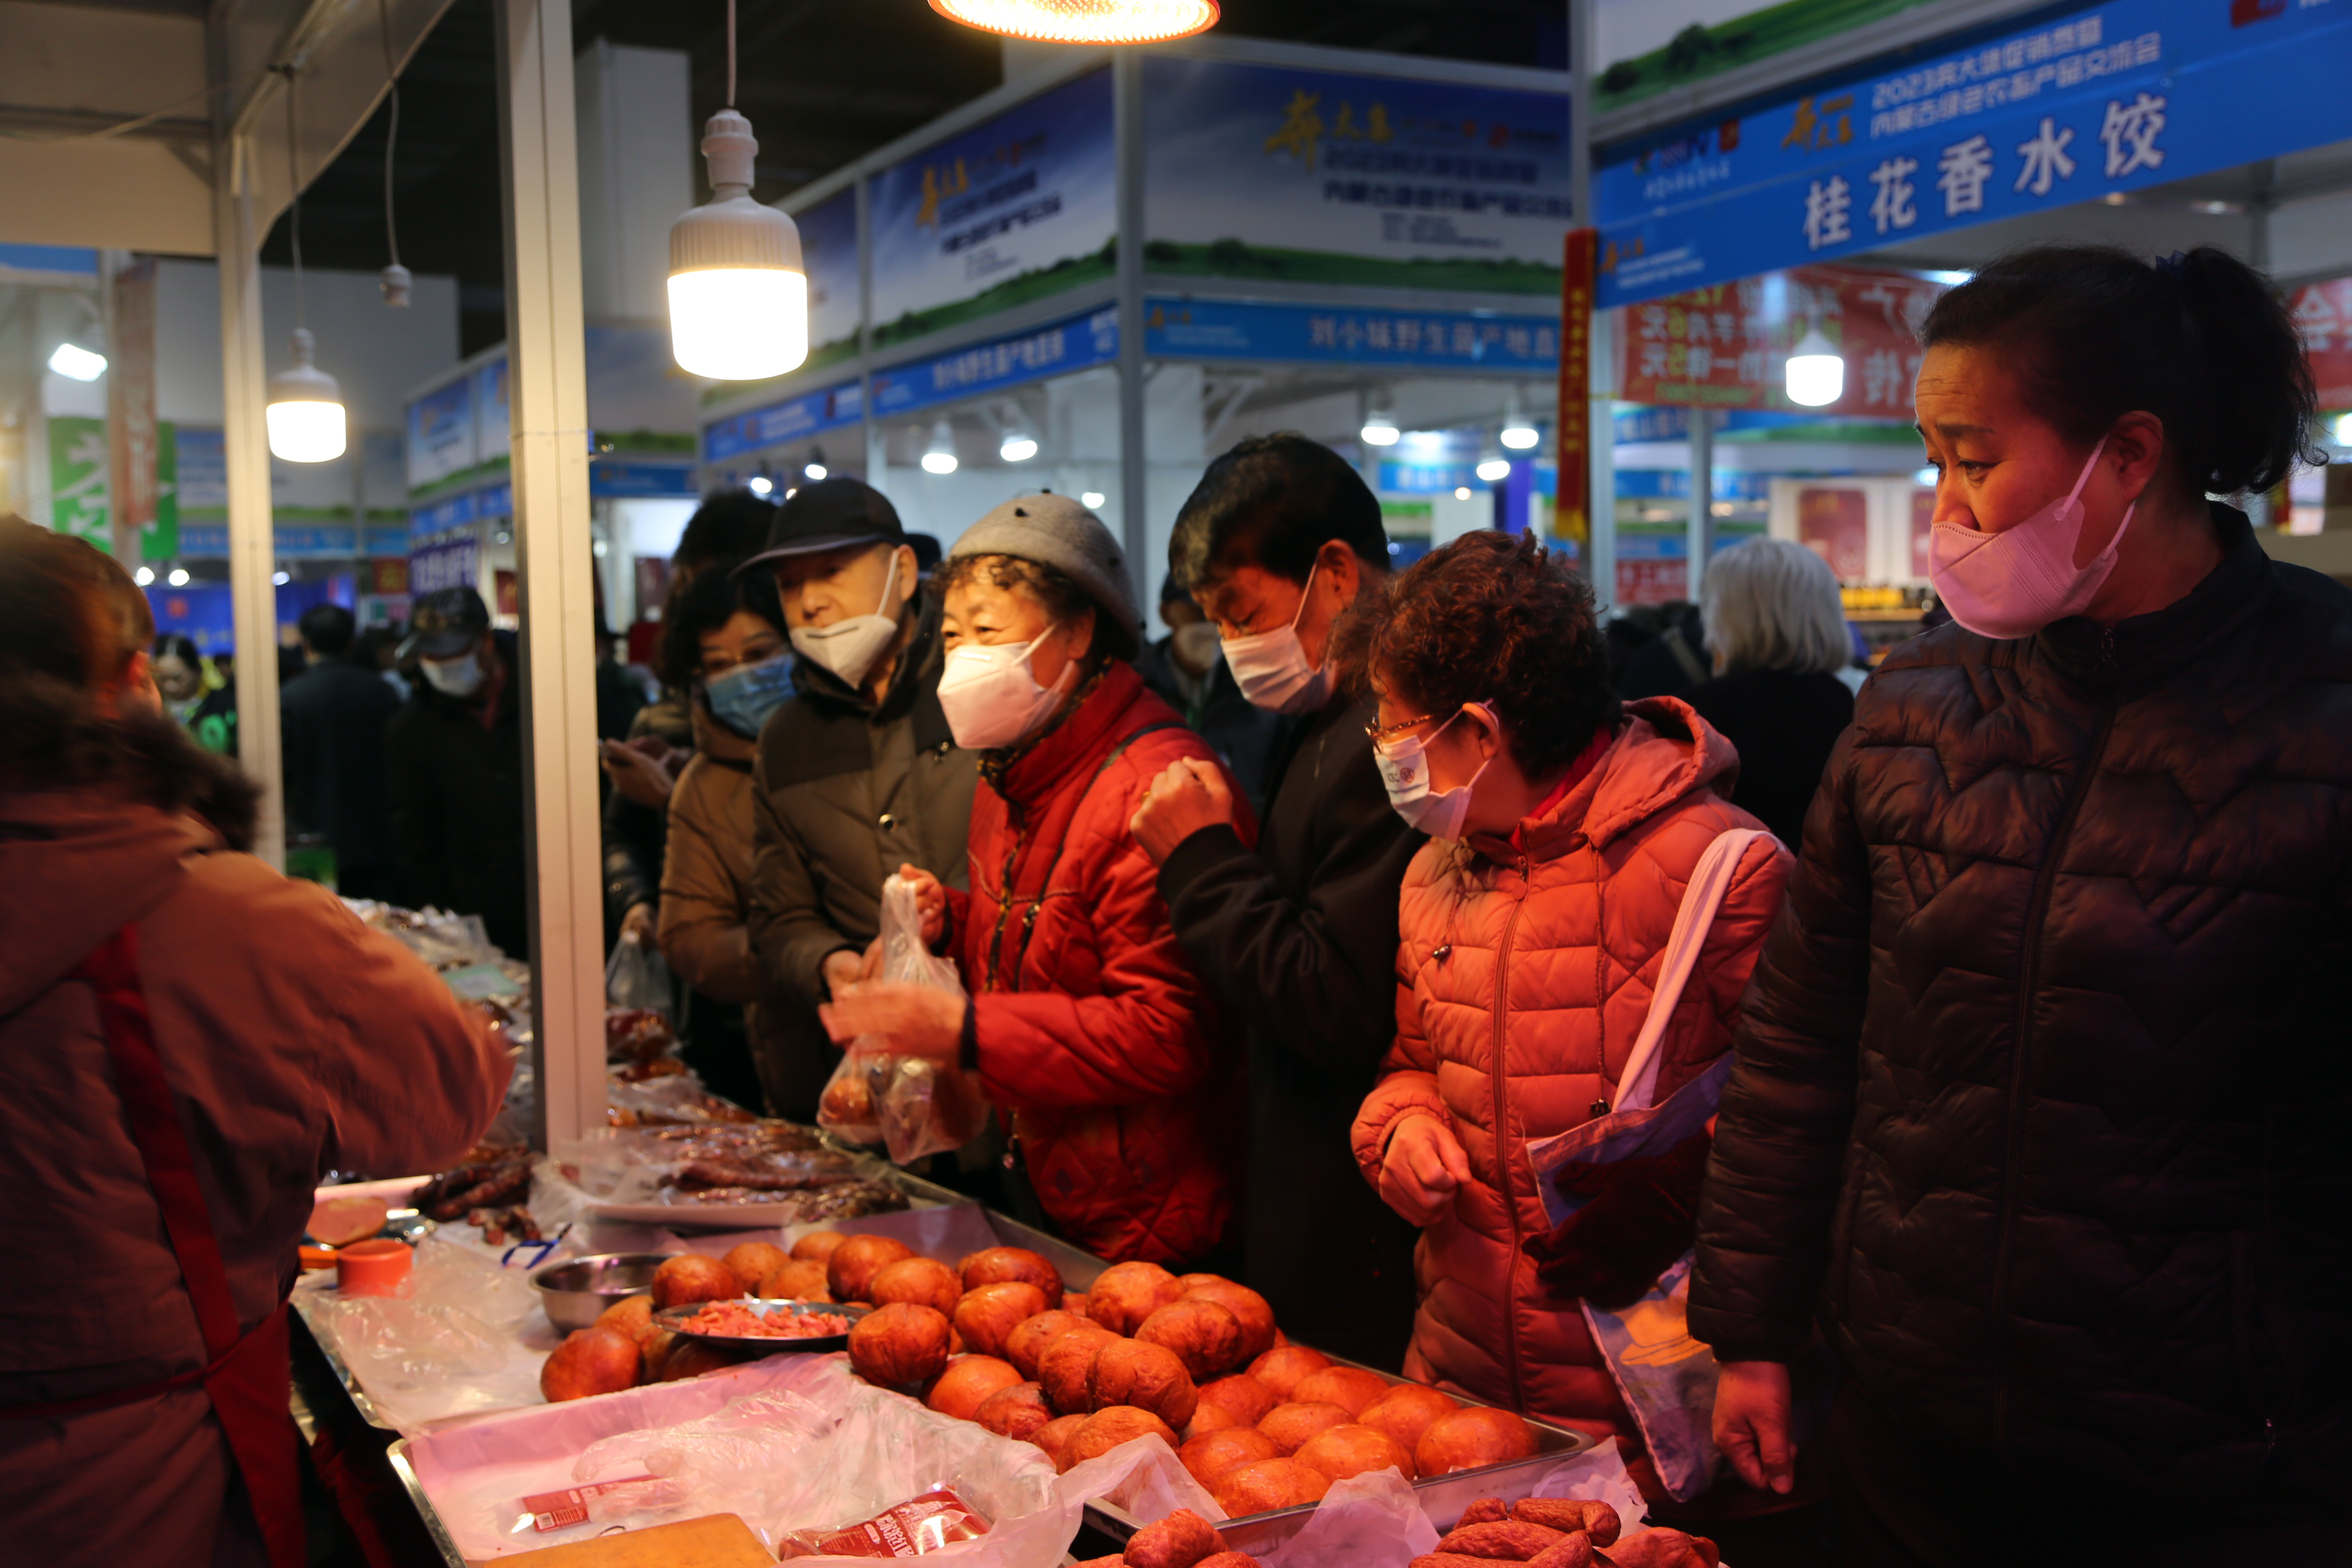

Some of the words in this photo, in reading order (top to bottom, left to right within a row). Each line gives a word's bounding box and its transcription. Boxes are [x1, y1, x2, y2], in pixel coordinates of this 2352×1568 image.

[1802, 94, 2167, 251] 桂花香水饺
